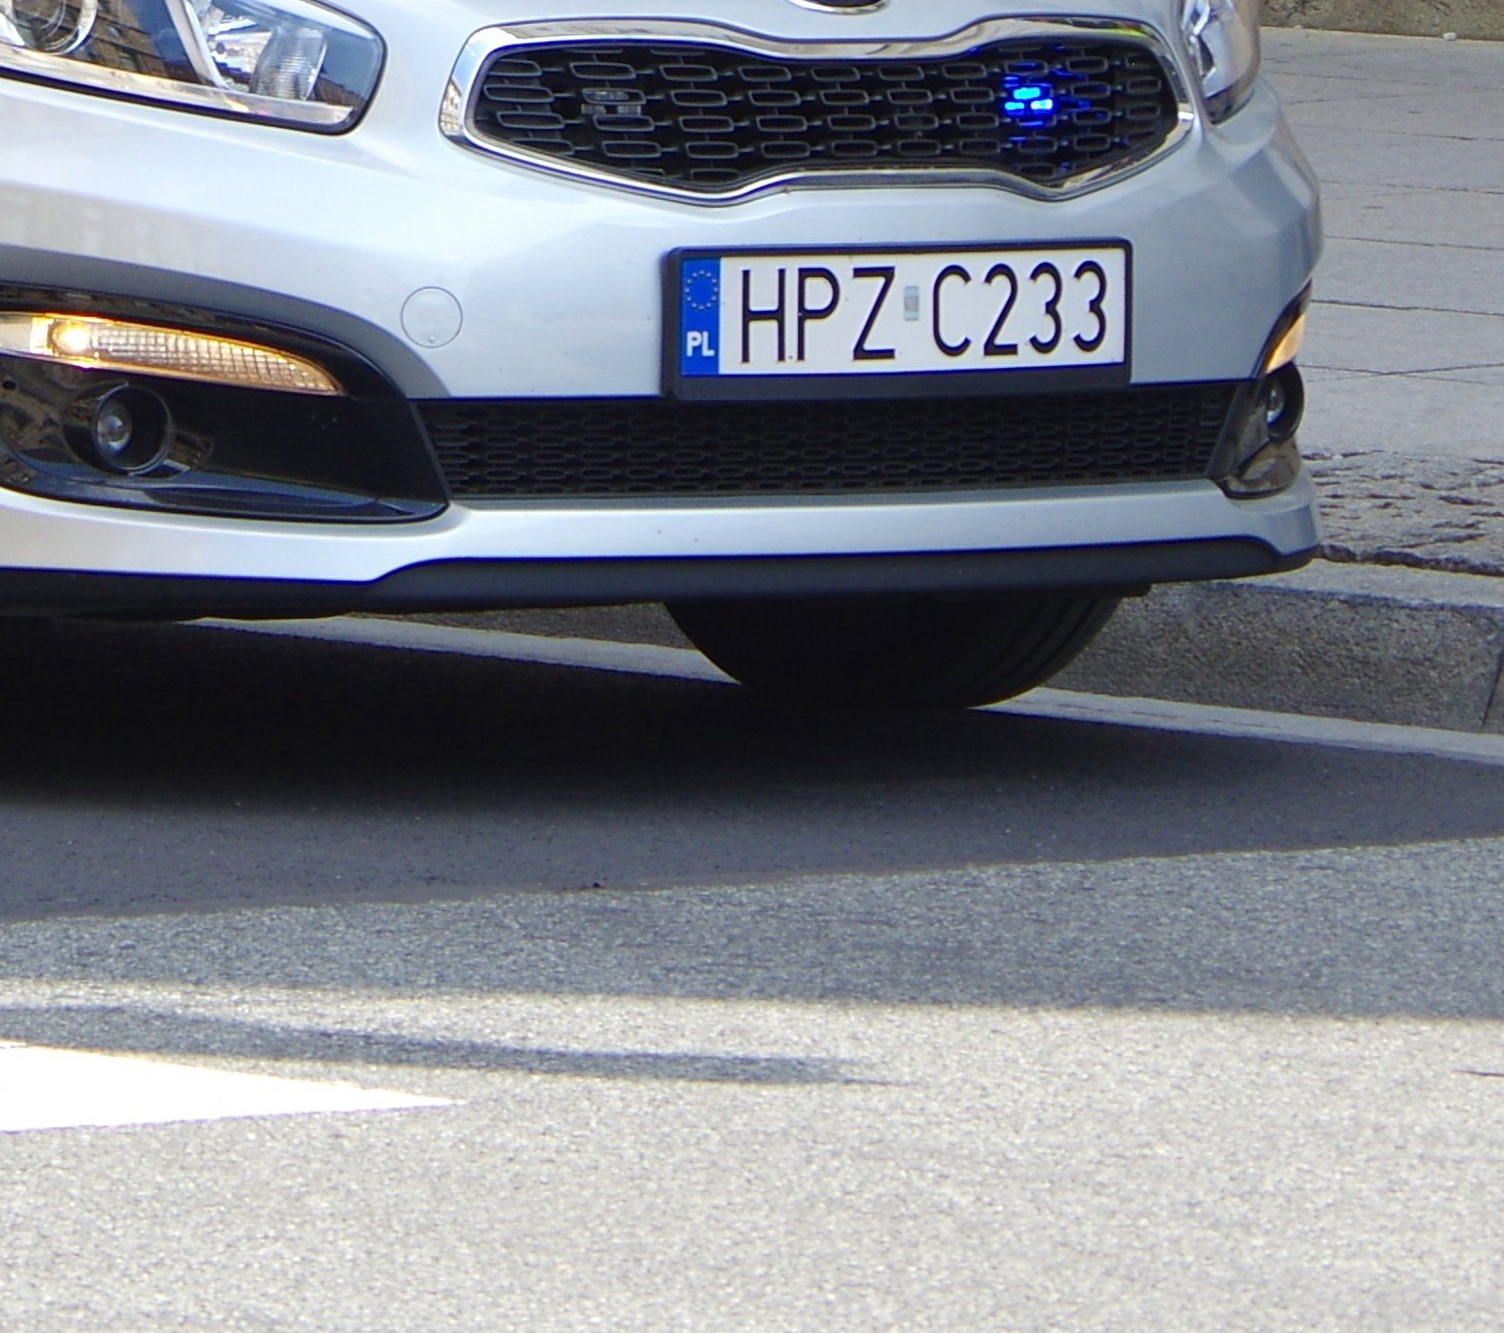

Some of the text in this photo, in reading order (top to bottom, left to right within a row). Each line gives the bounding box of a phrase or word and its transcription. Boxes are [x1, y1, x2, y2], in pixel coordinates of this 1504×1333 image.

[686, 331, 716, 357] PL
[740, 259, 1108, 364] HPZ C233
